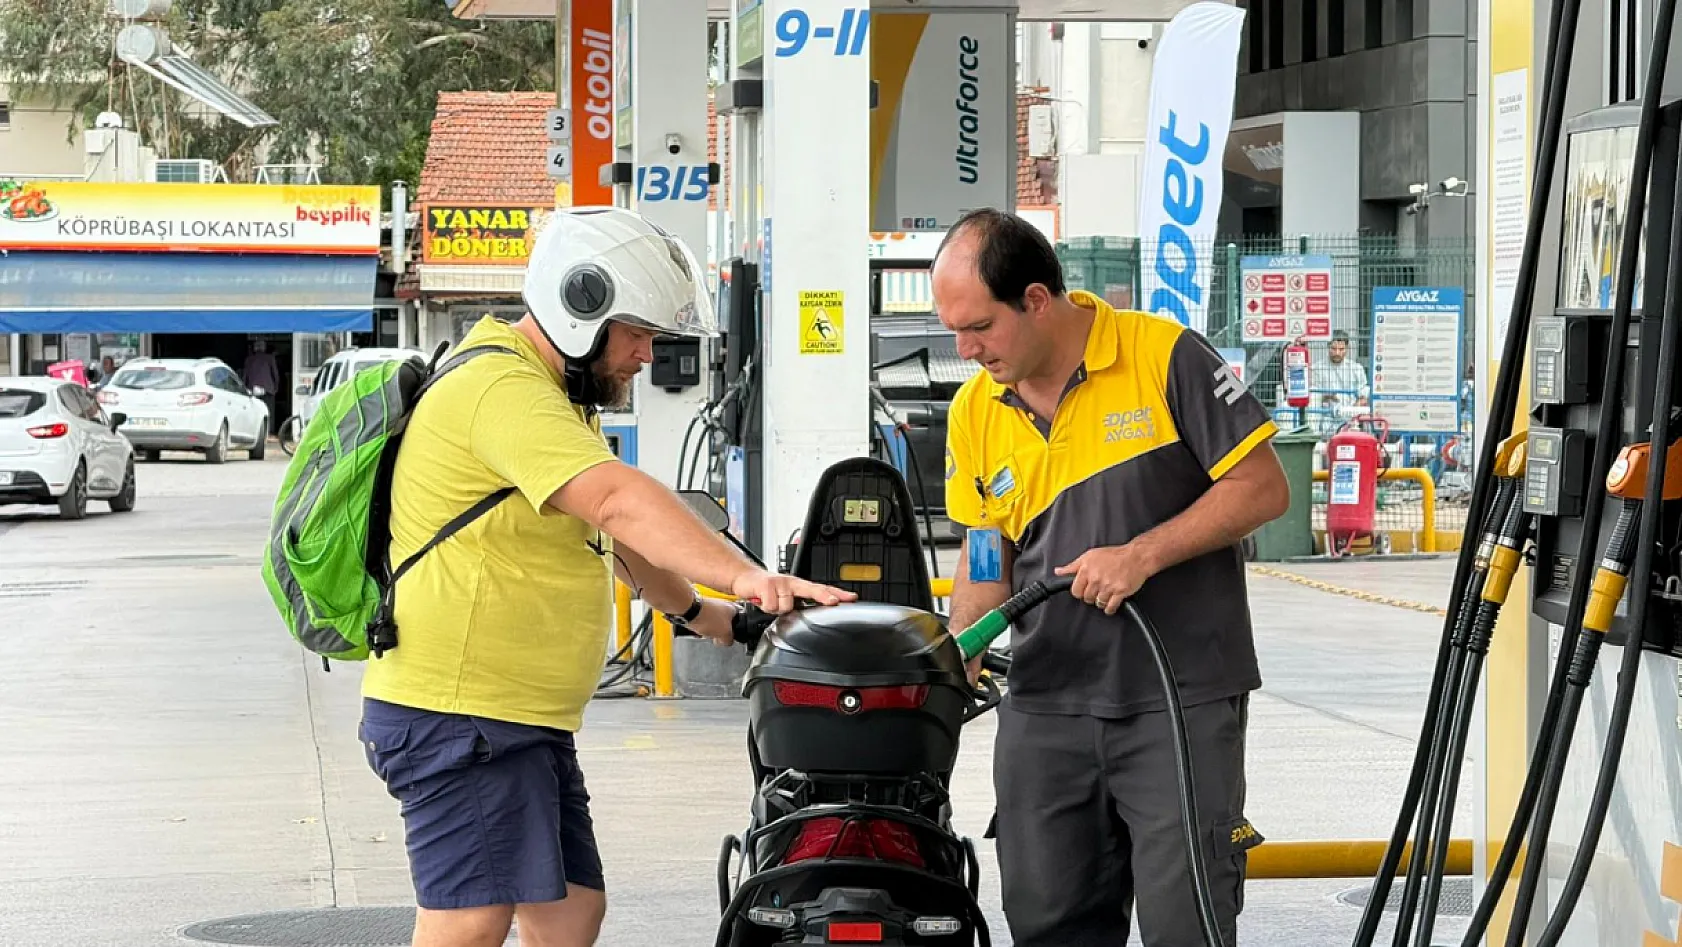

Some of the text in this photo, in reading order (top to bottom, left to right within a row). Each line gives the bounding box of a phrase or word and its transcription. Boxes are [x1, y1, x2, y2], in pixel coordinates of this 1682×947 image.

[582, 28, 612, 139] otobil
[956, 36, 979, 184] ultraforce
[553, 116, 565, 131] 3
[553, 153, 565, 168] 4
[57, 215, 295, 240] KÖPRÜBAŞI LOKANTASI
[431, 209, 529, 229] YANAR
[431, 232, 527, 257] DÖNER
[1268, 257, 1304, 267] AYGAZ
[1395, 290, 1439, 302] AYGAZ
